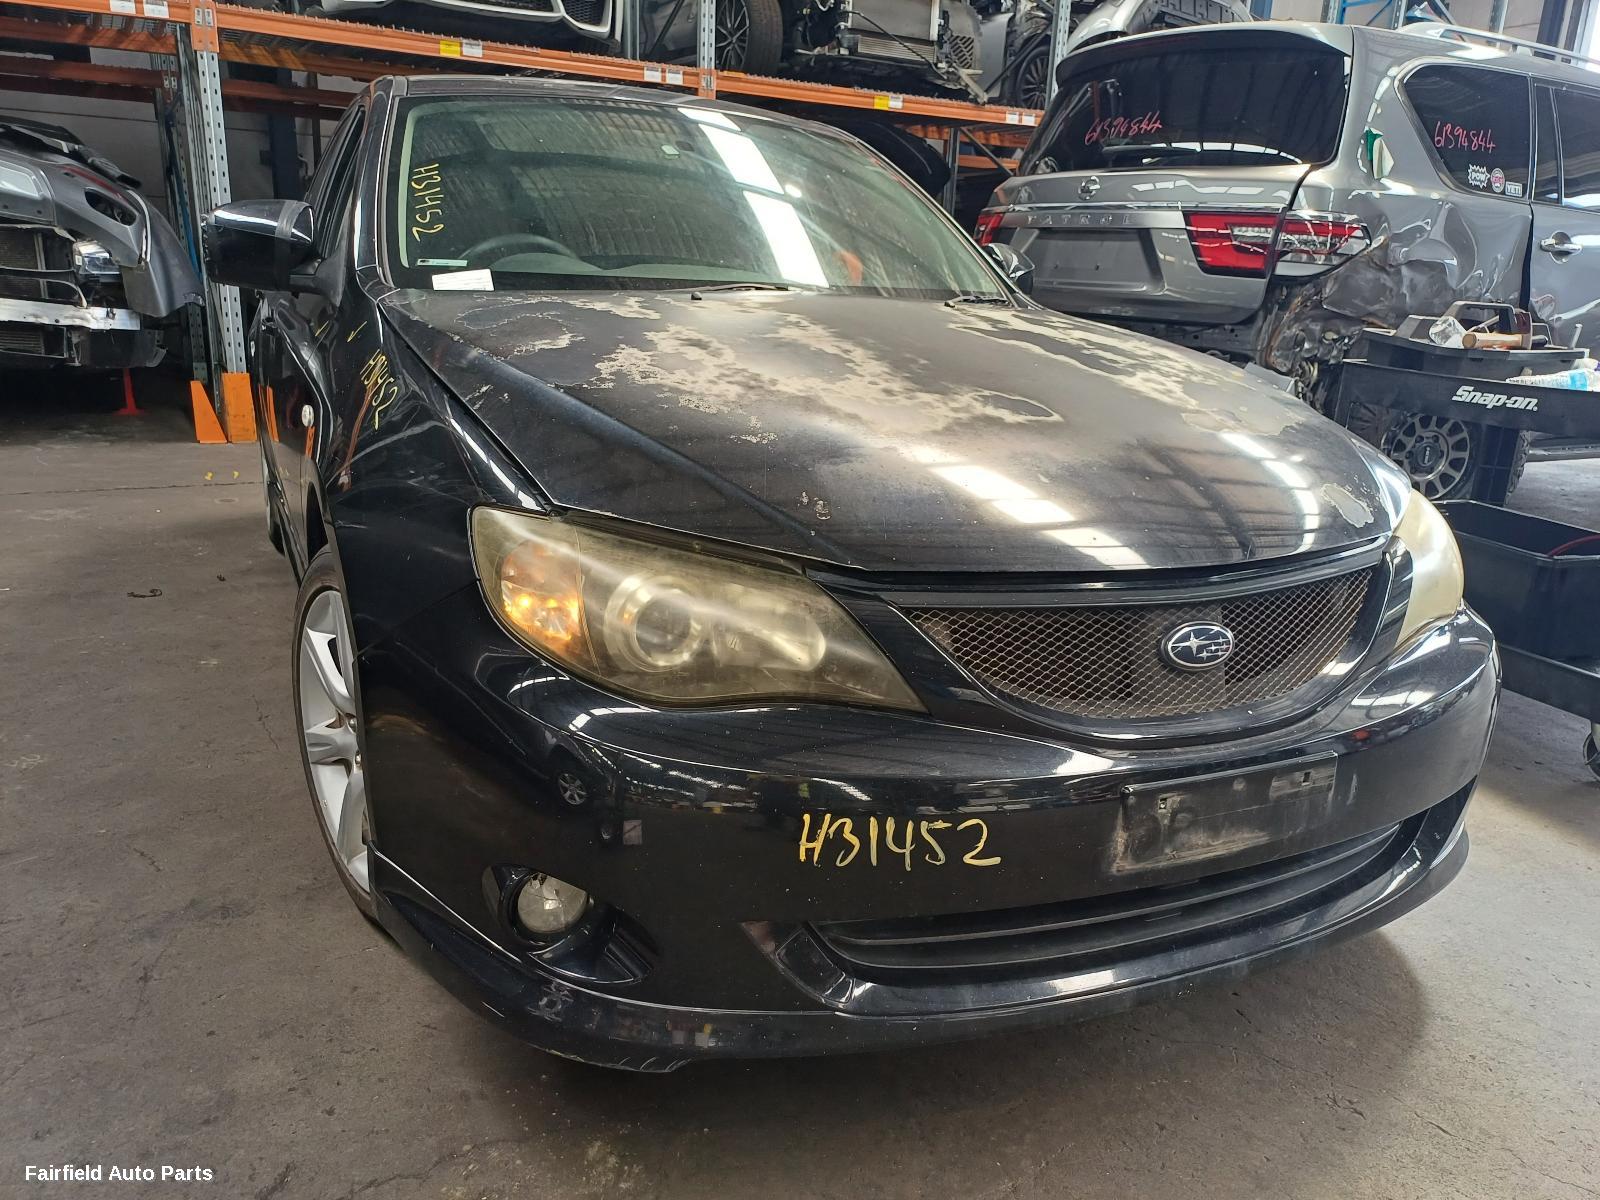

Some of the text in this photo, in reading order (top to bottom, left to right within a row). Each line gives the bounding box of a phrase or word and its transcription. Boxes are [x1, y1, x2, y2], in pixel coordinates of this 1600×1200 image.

[1434, 120, 1496, 153] 61394844
[1471, 171, 1487, 181] POW
[1507, 185, 1521, 195] YETI
[410, 163, 445, 242] H31452
[799, 813, 1002, 872] H31452
